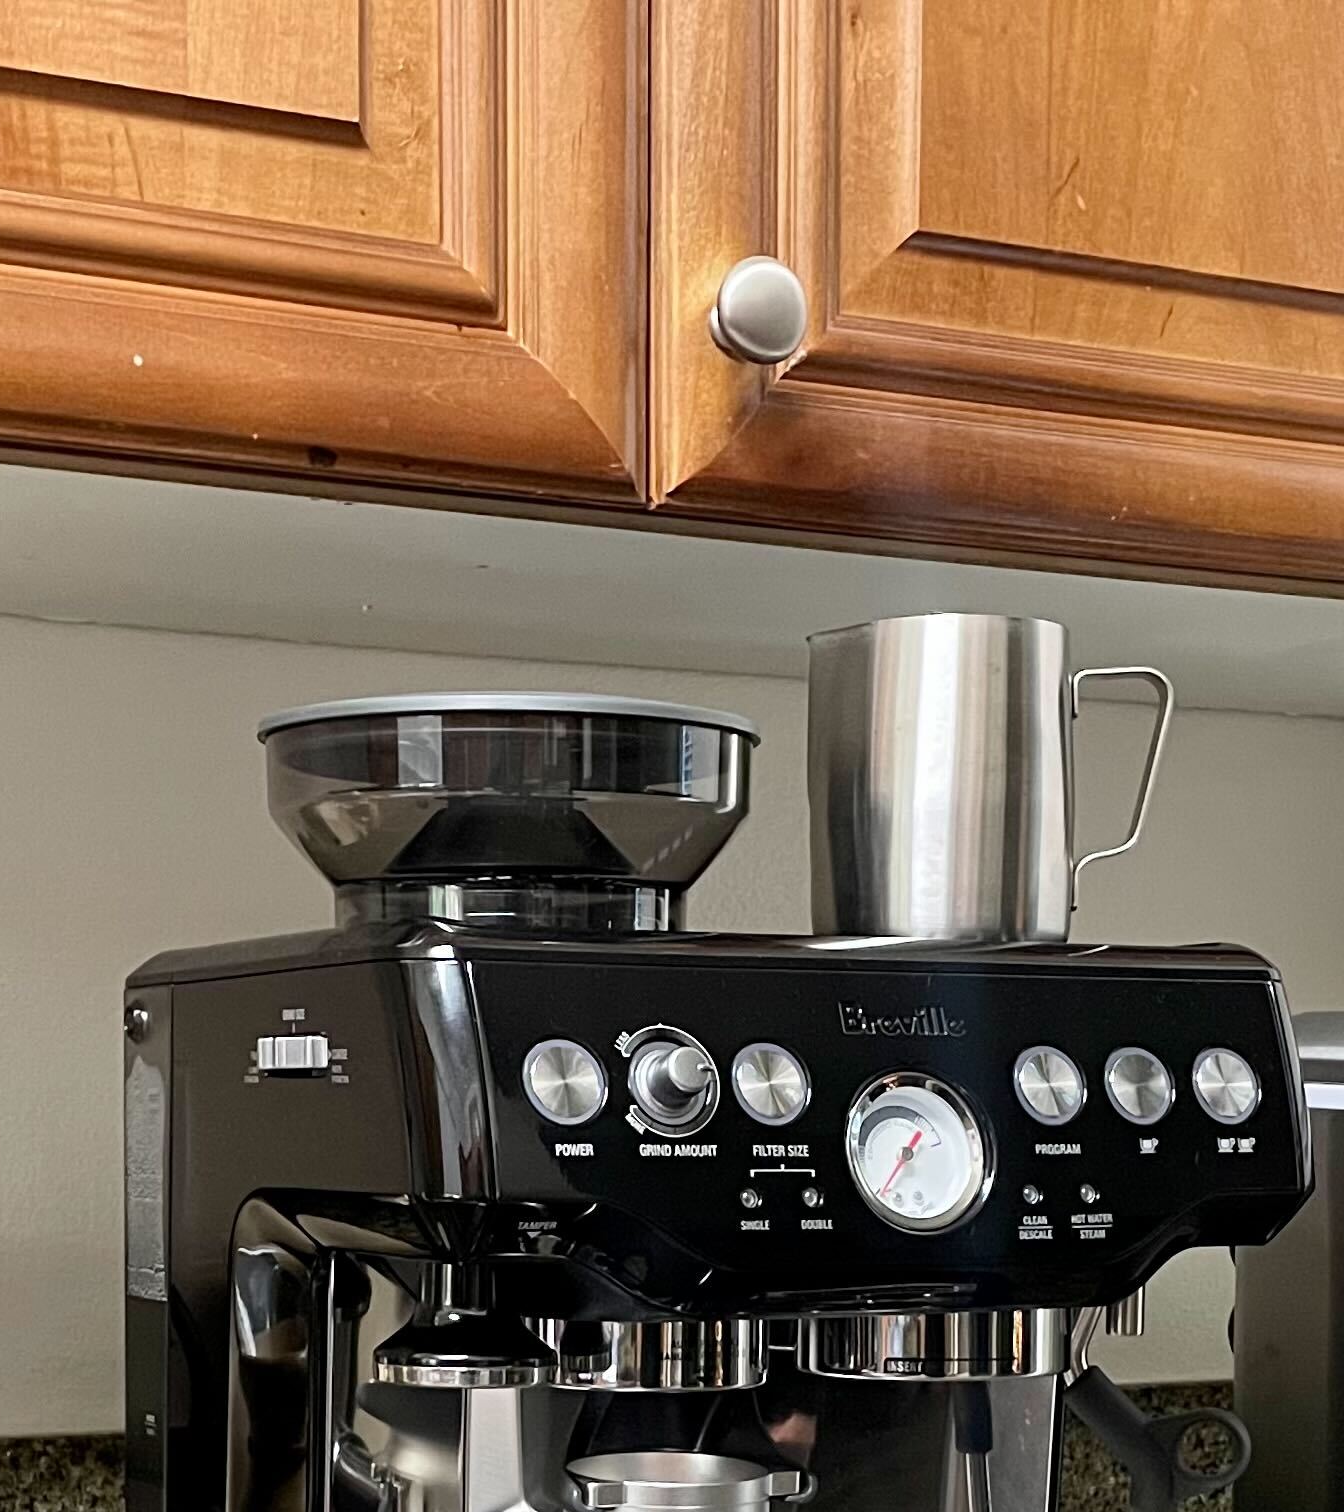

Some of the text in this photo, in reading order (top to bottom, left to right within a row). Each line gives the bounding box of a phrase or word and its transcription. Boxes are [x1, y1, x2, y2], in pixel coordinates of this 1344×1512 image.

[838, 1001, 967, 1037] Breville
[555, 1143, 595, 1157] POWER
[639, 1143, 718, 1158] GRIND AMOUNT
[752, 1144, 810, 1157] FILTER SIZE
[1035, 1143, 1081, 1155] PROGRAM
[740, 1219, 770, 1230] SINGLE
[800, 1219, 834, 1230] DOUBLE
